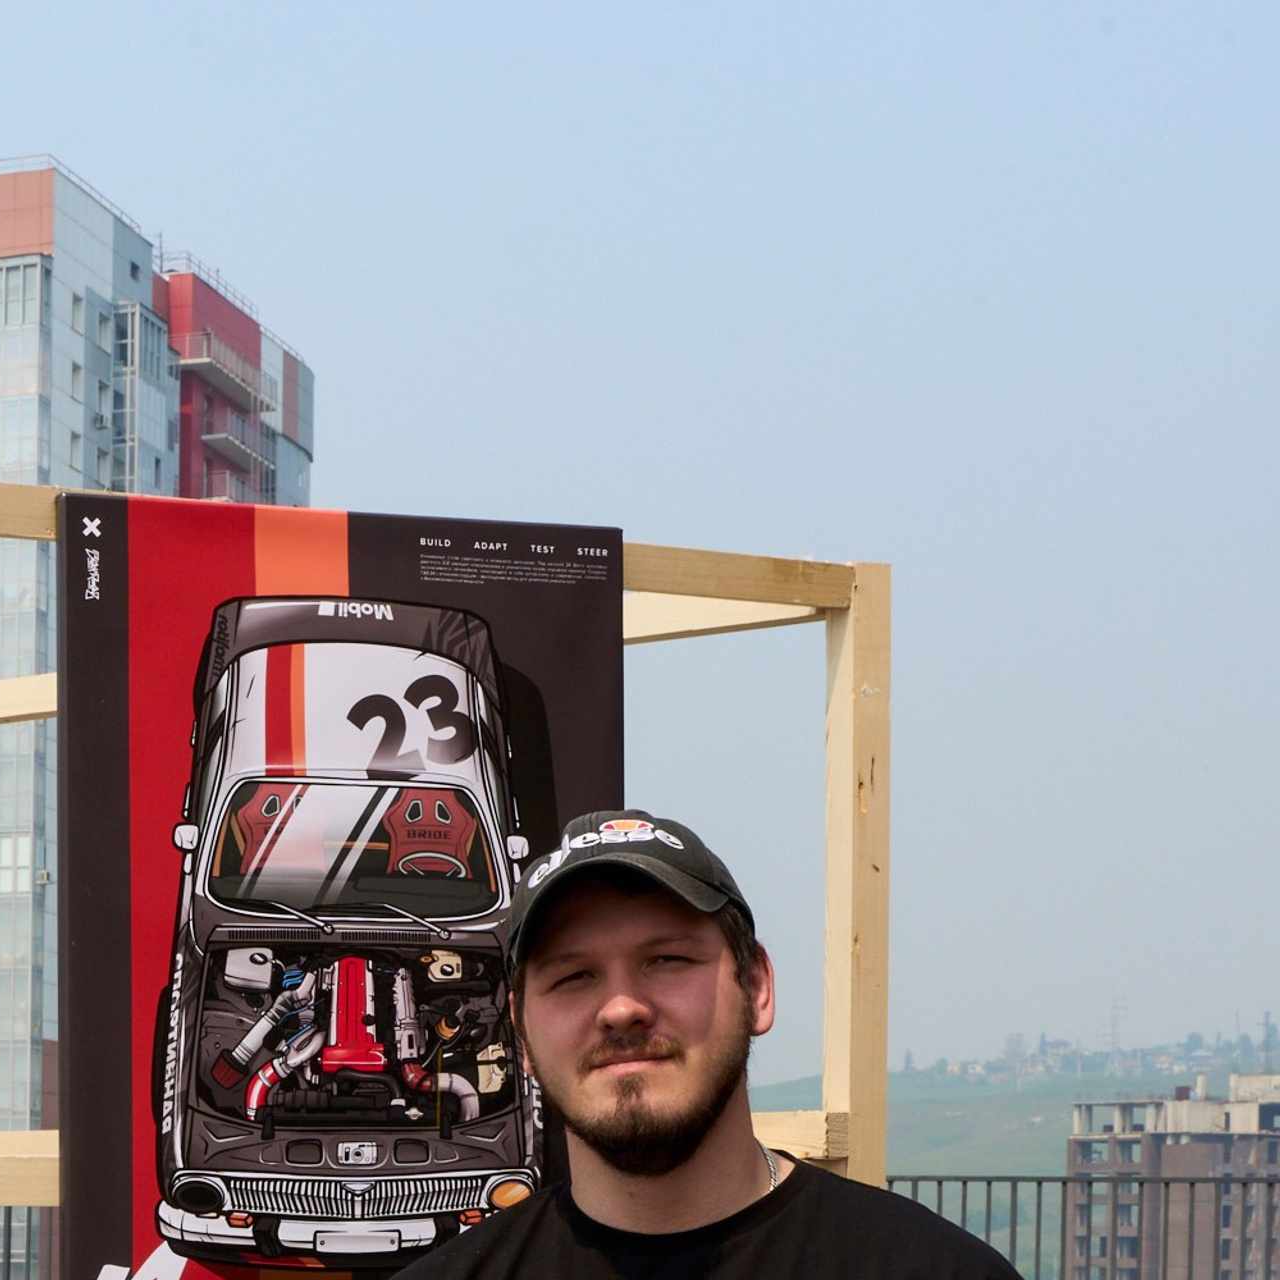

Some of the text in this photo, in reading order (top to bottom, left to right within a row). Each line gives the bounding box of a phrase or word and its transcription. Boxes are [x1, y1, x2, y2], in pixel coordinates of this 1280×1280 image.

[420, 537, 608, 557] BUILD ADAPT TEST STEER
[338, 602, 394, 620] Mobil
[347, 674, 478, 780] 23
[406, 829, 452, 839] BRIDE
[528, 832, 684, 888] ellesse
